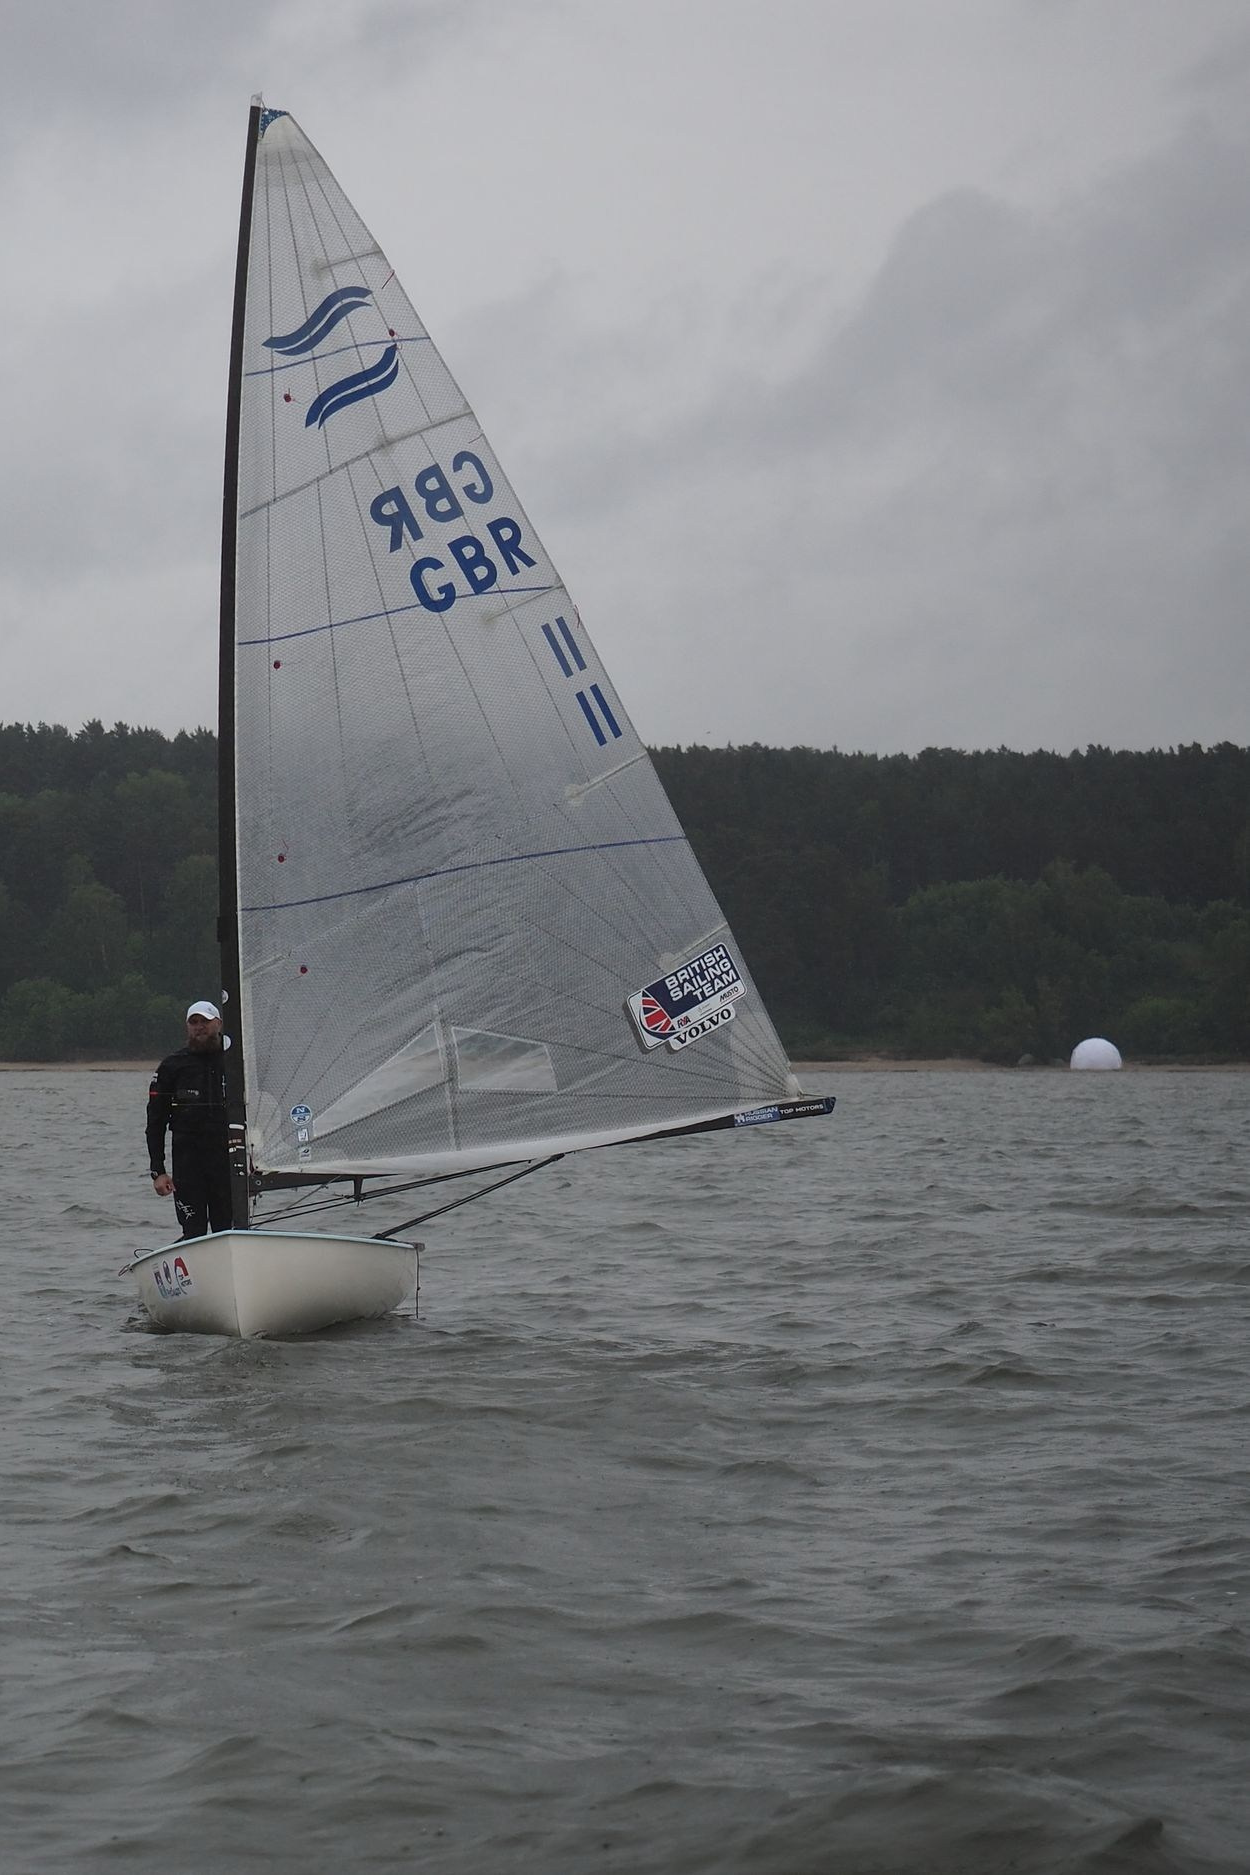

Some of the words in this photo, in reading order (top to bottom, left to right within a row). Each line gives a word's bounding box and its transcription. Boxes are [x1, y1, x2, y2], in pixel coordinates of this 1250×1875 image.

[409, 516, 537, 613] GBR
[575, 683, 622, 747] 11
[664, 946, 726, 990] BRITISH
[671, 959, 732, 1002] SAILING
[692, 970, 737, 1001] TEAM
[719, 986, 740, 1003] MUSTO
[673, 1008, 732, 1046] VOLVO
[795, 1103, 824, 1113] MOTORS
